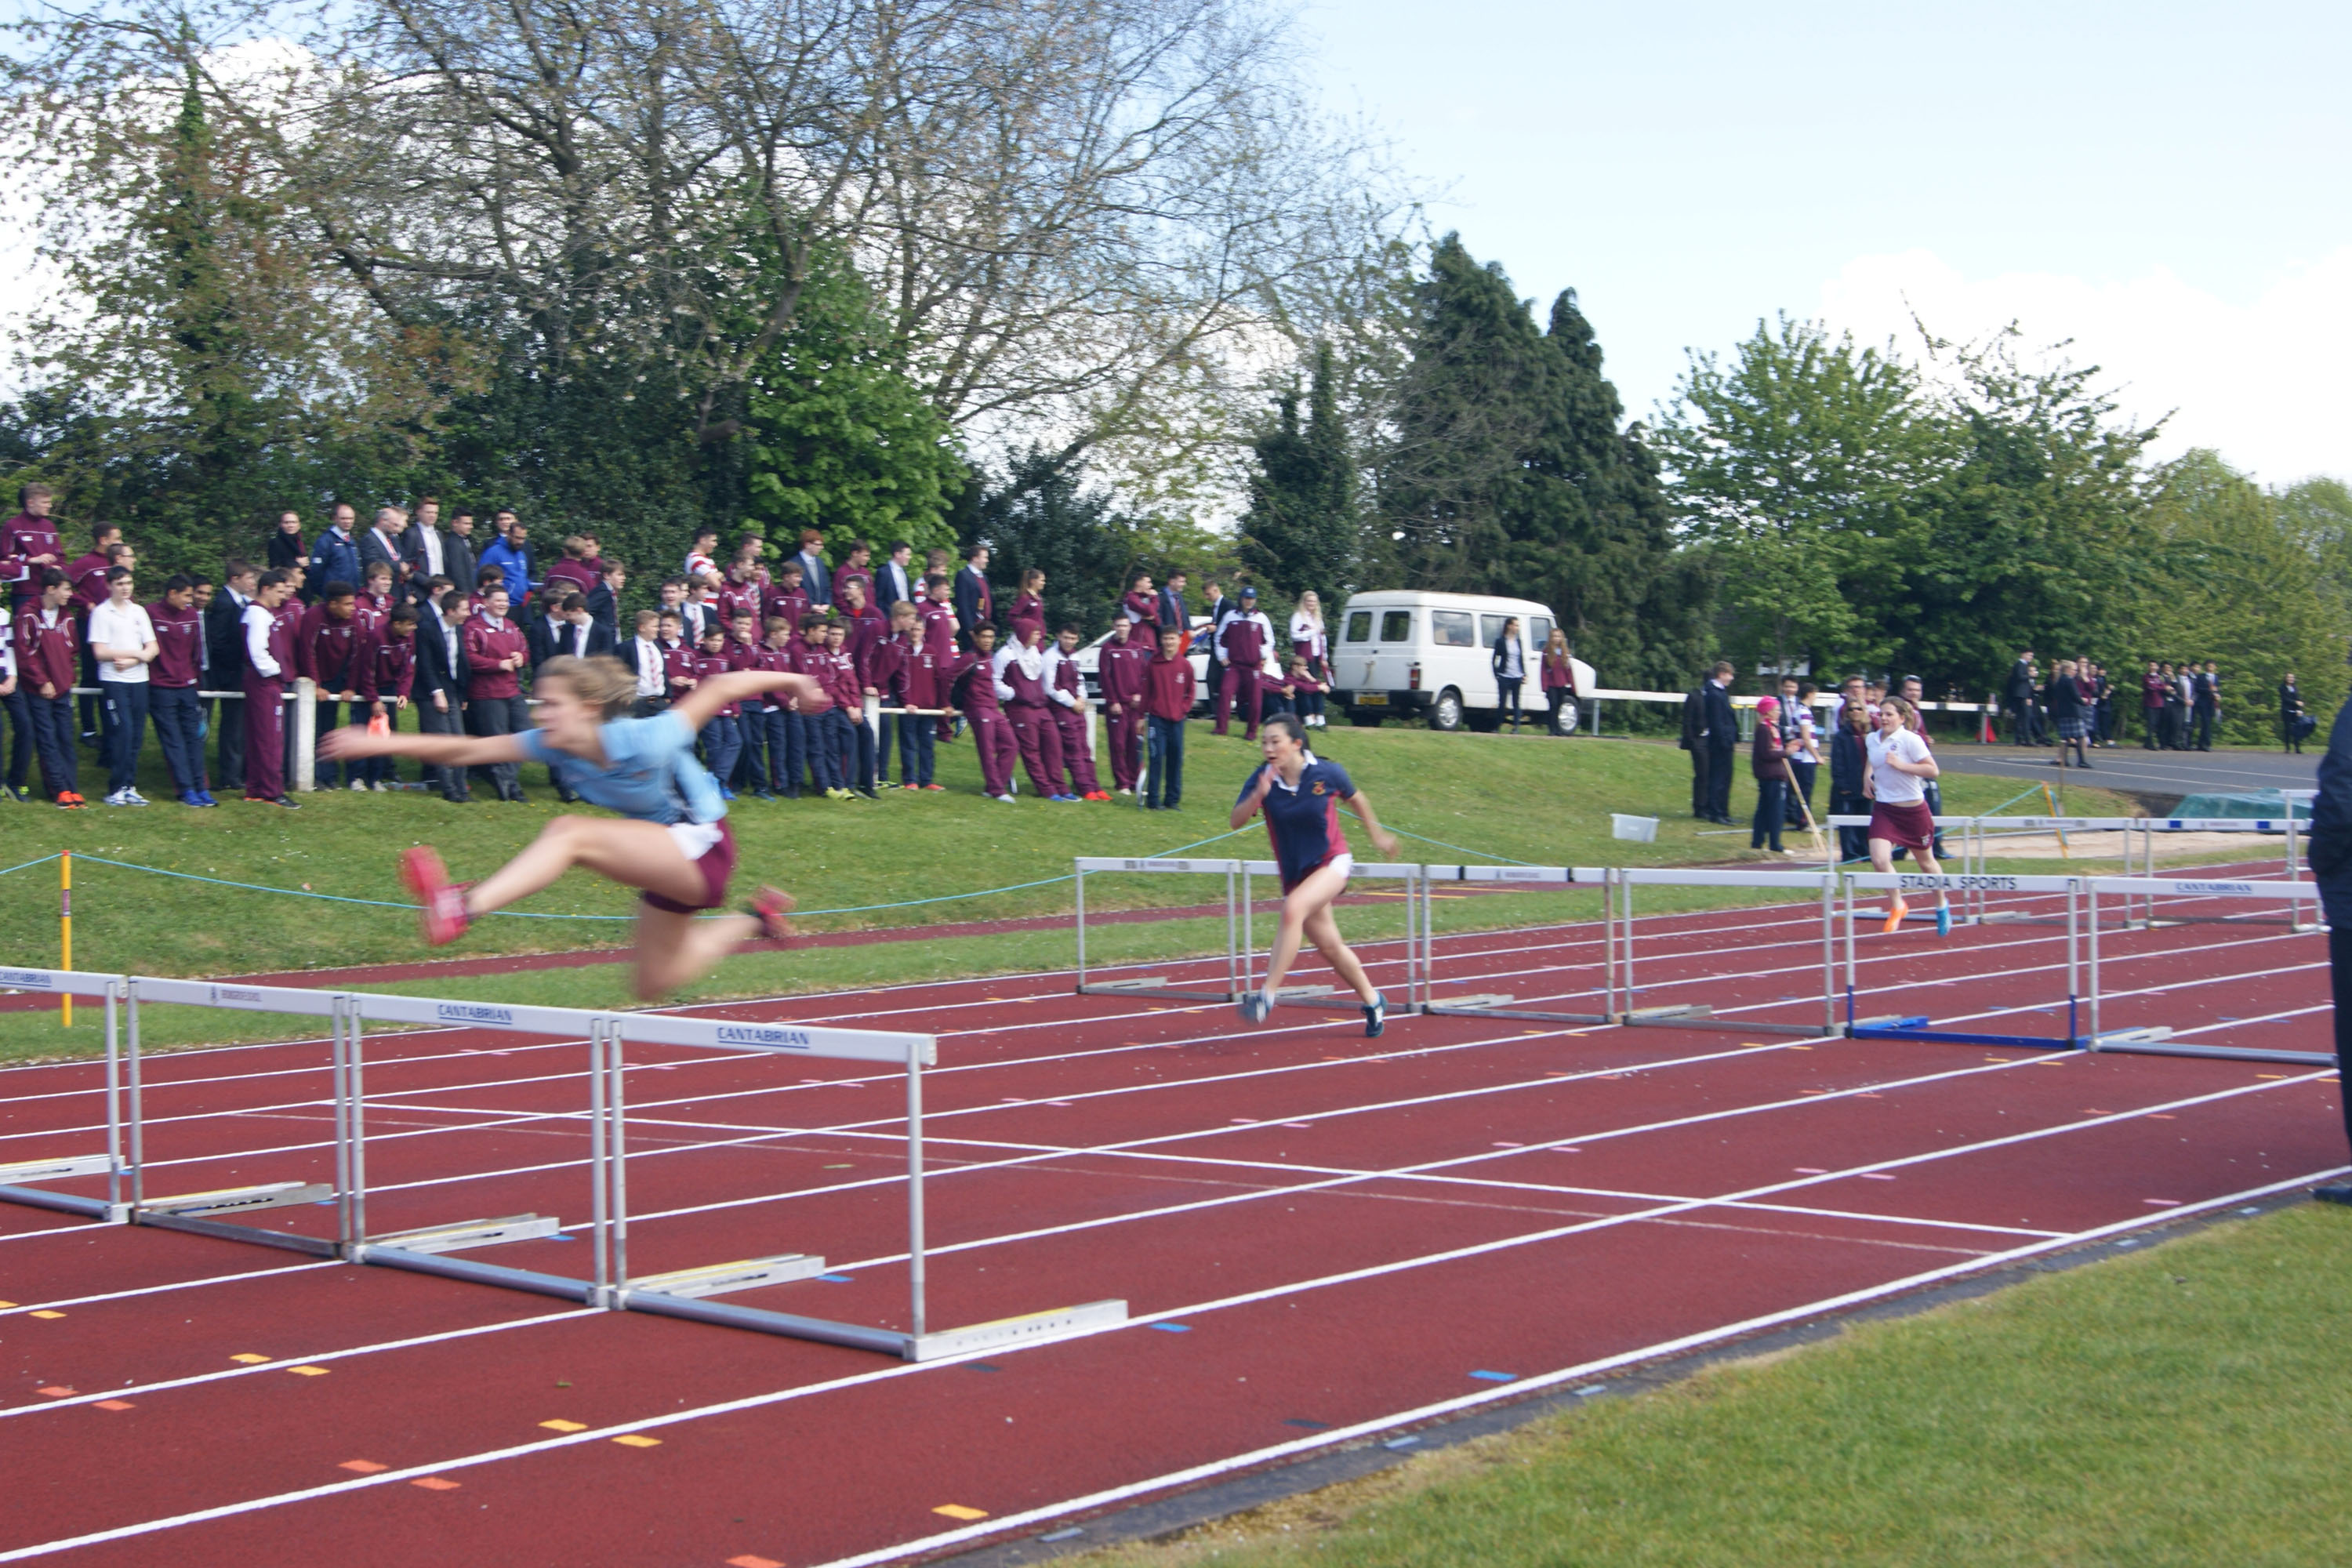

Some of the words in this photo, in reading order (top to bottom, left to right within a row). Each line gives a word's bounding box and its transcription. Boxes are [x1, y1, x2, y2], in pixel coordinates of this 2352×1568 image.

[1900, 875, 1951, 888] STADIA
[1960, 877, 2017, 890] SPORTS
[2176, 882, 2252, 892] CANTABRIAN
[437, 1004, 512, 1021] CANTABRIAN
[717, 1027, 809, 1045] CANTABRIAN
